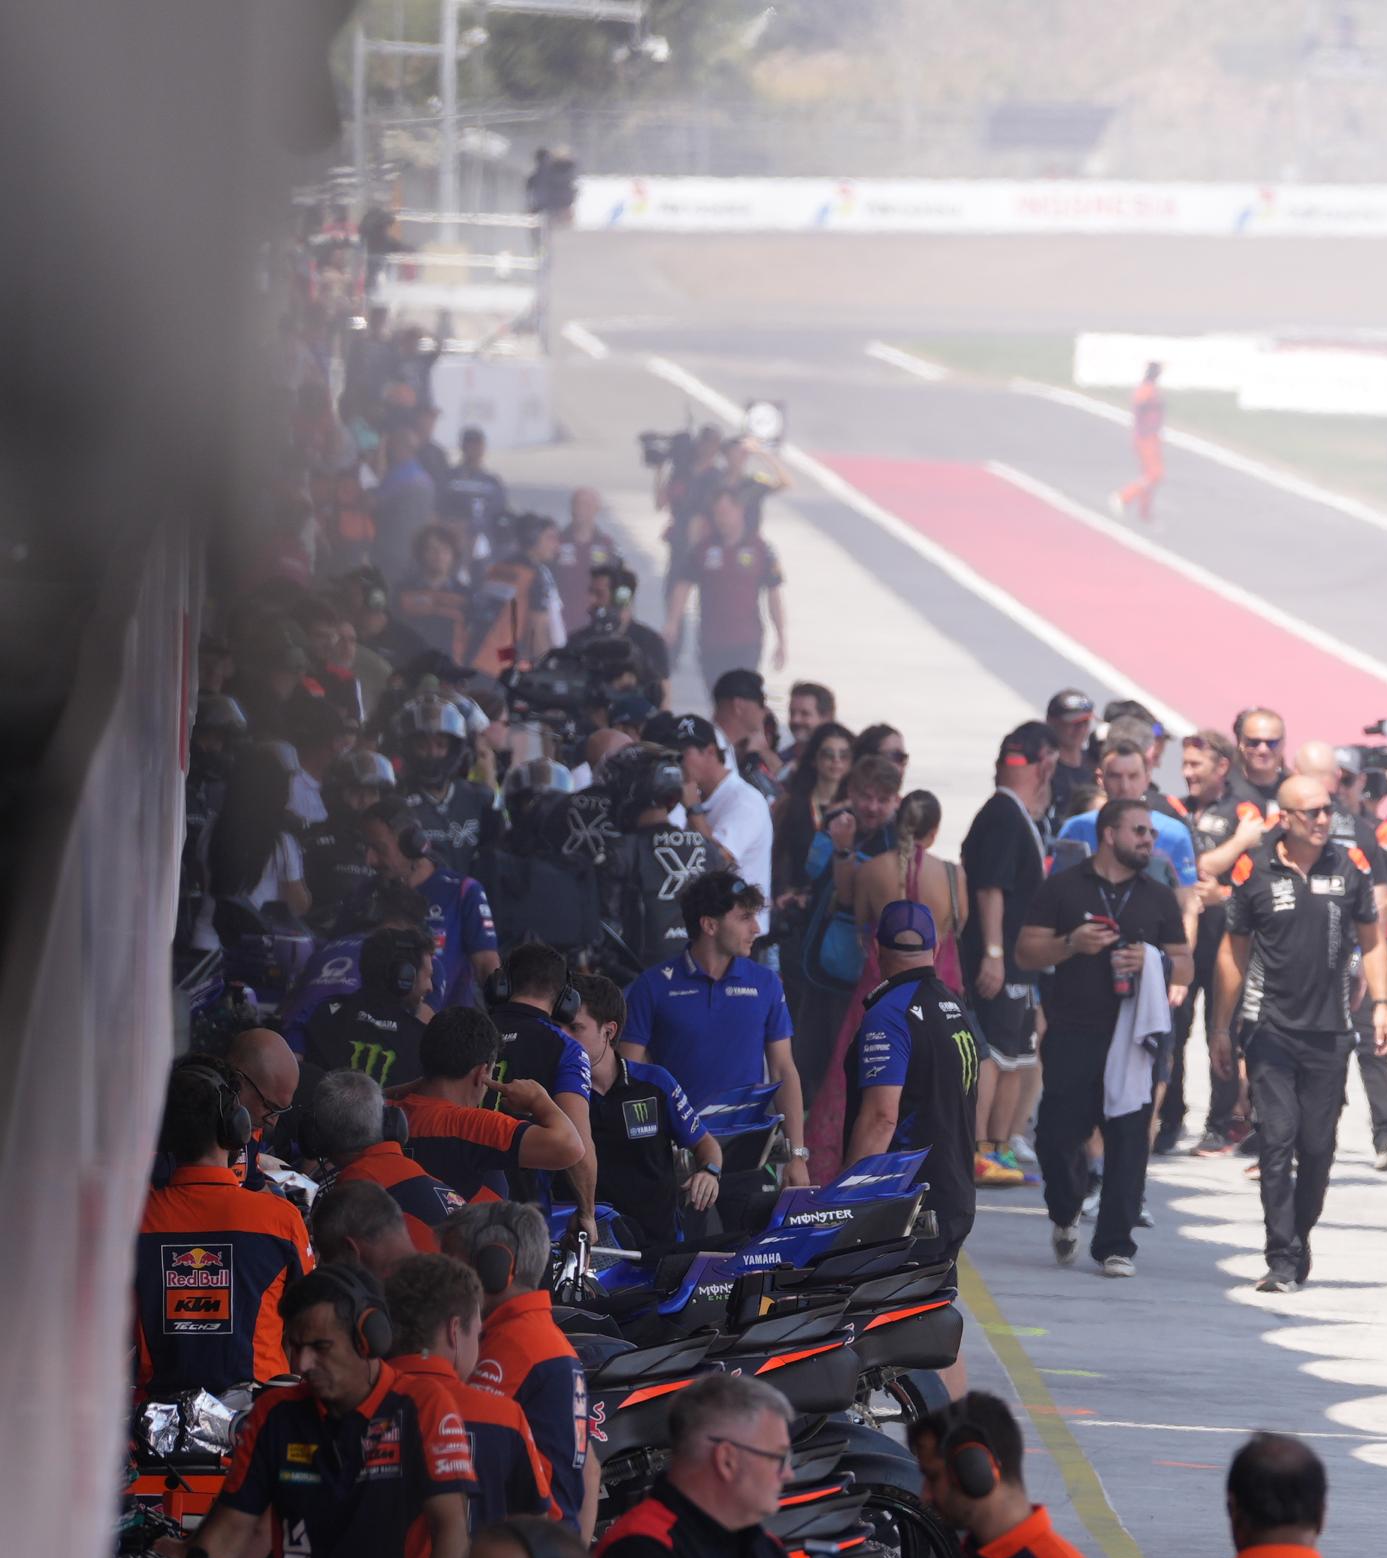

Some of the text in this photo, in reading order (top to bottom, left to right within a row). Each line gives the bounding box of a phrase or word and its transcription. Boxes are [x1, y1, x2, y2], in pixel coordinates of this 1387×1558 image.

[733, 986, 758, 997] YAMAHA
[789, 1208, 855, 1226] MONSTER
[743, 1253, 782, 1266] YAMAHA
[165, 1269, 230, 1288] Red Bull
[173, 1295, 223, 1313] KTM
[173, 1321, 222, 1331] TECH3
